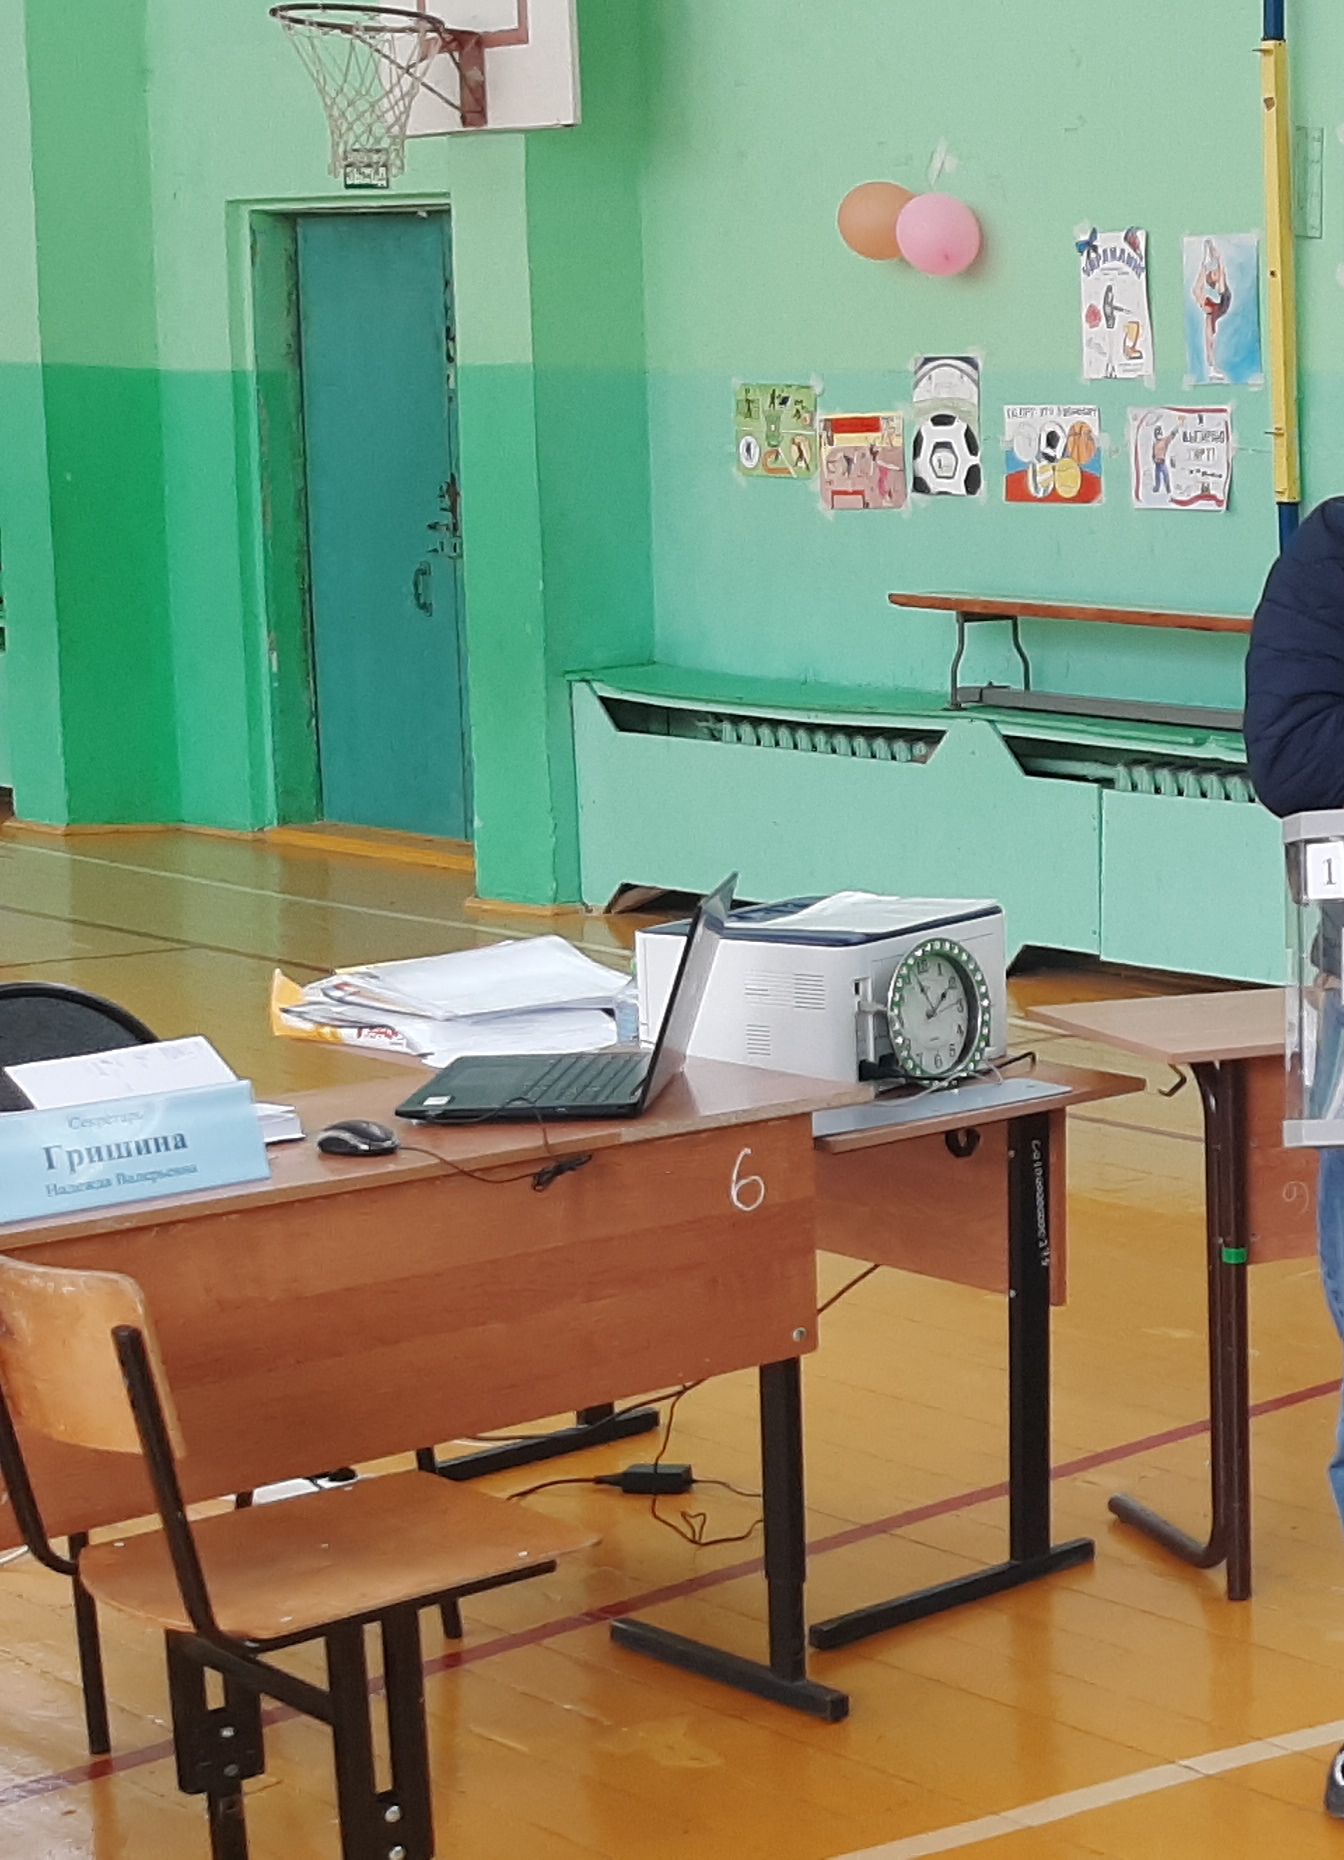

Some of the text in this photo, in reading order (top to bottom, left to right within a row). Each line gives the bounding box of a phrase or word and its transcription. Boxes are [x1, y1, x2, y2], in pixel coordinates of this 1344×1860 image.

[1323, 857, 1337, 886] 1
[42, 1132, 189, 1175] Гришина
[46, 1164, 199, 1198] Надежда Валерьевна
[731, 1147, 765, 1211] 6
